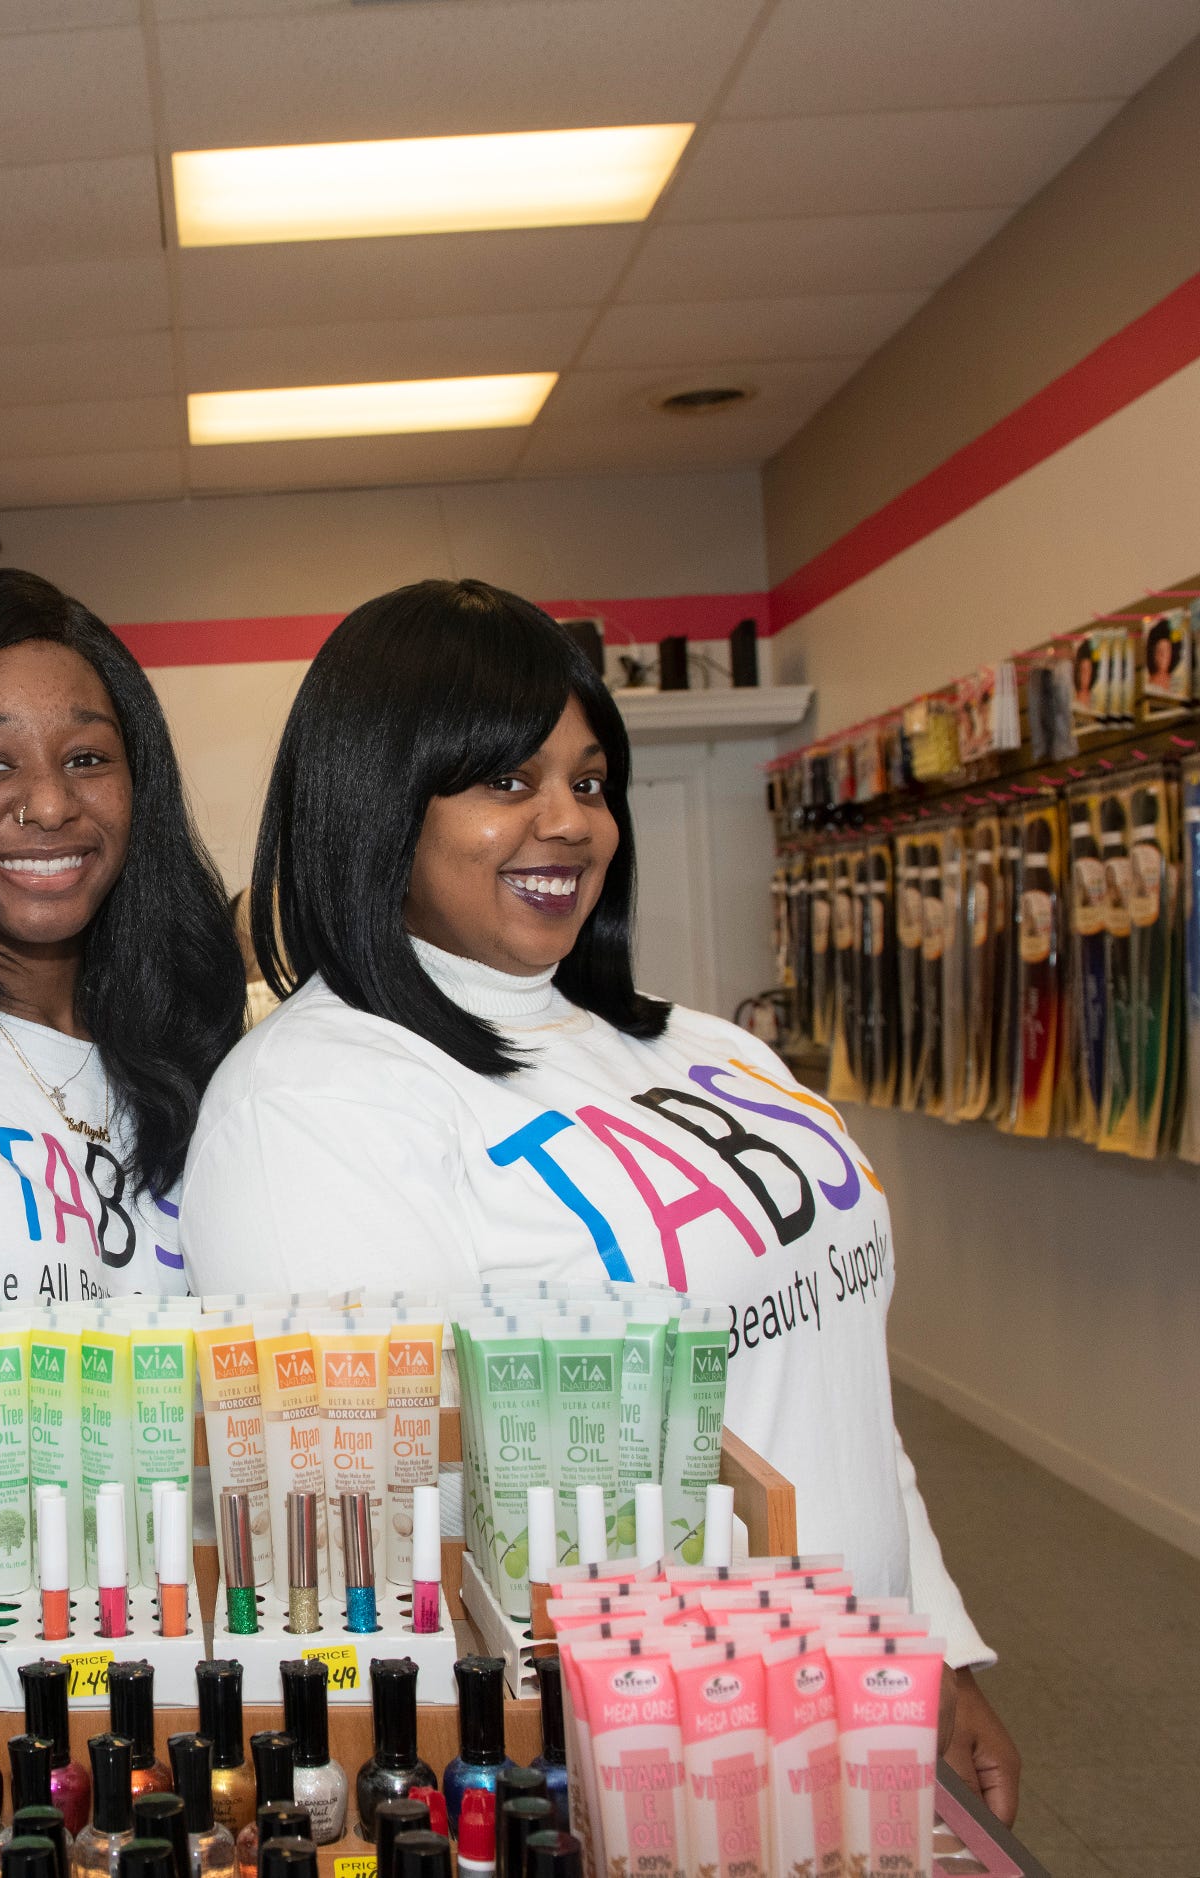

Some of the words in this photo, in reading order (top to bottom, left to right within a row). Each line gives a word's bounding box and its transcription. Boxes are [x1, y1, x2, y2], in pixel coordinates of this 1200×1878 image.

[39, 1262, 69, 1302] All
[219, 1388, 241, 1398] ULTRA
[388, 1387, 411, 1395] ULTRA
[415, 1386, 433, 1394] CARE
[492, 1380, 539, 1391] NATURAL
[562, 1381, 611, 1391] NATURAL
[328, 1398, 352, 1406] ULTRA
[356, 1398, 376, 1406] CARE
[387, 1397, 435, 1408] MOROCCAN
[492, 1400, 517, 1409] ULTRA
[521, 1399, 541, 1408] CARE
[562, 1401, 587, 1409] ULTRA
[591, 1400, 611, 1409] CARE
[621, 1396, 641, 1423] ive
[0, 1404, 23, 1426] Tree
[44, 1402, 63, 1427] Tree
[81, 1406, 90, 1423] ea
[93, 1402, 112, 1428] Tree
[136, 1401, 157, 1424] Tea
[159, 1401, 184, 1423] Tree
[282, 1405, 320, 1421] MOROCCA
[328, 1409, 377, 1419] MOROCCAN
[697, 1406, 721, 1433] Olive
[32, 1426, 59, 1446] OIL
[81, 1426, 108, 1446] OIL
[142, 1427, 182, 1443] OIL
[227, 1415, 261, 1442] Argan
[393, 1414, 431, 1442] Argan
[500, 1415, 536, 1443] Olive
[569, 1415, 605, 1444] Olive
[620, 1427, 644, 1442] IL
[290, 1425, 320, 1453] Argan
[333, 1425, 373, 1455] Argan
[694, 1435, 721, 1452] OIL
[227, 1441, 263, 1458] OIL
[393, 1441, 432, 1457] OIL
[499, 1445, 541, 1462] OIL
[567, 1446, 609, 1463] OIL
[290, 1453, 321, 1470] OIL
[333, 1453, 374, 1470] OIL
[66, 1656, 108, 1666] PRICE
[307, 1650, 351, 1660] PRICE
[71, 1670, 109, 1695] 1.49
[614, 1674, 658, 1688] Difeel
[705, 1681, 740, 1697] Difeel
[866, 1674, 909, 1688] Difeel
[603, 1702, 638, 1723] MEGA
[641, 1699, 676, 1721] CARE
[695, 1711, 727, 1734] MEGA
[731, 1702, 759, 1727] CARE
[853, 1702, 889, 1722] MEGA
[893, 1701, 926, 1721] CARE
[309, 1806, 328, 1816] Nail
[632, 1823, 673, 1849] OIL
[876, 1822, 917, 1848] OIL
[637, 1855, 672, 1871] 99%
[879, 1854, 913, 1870] 99%
